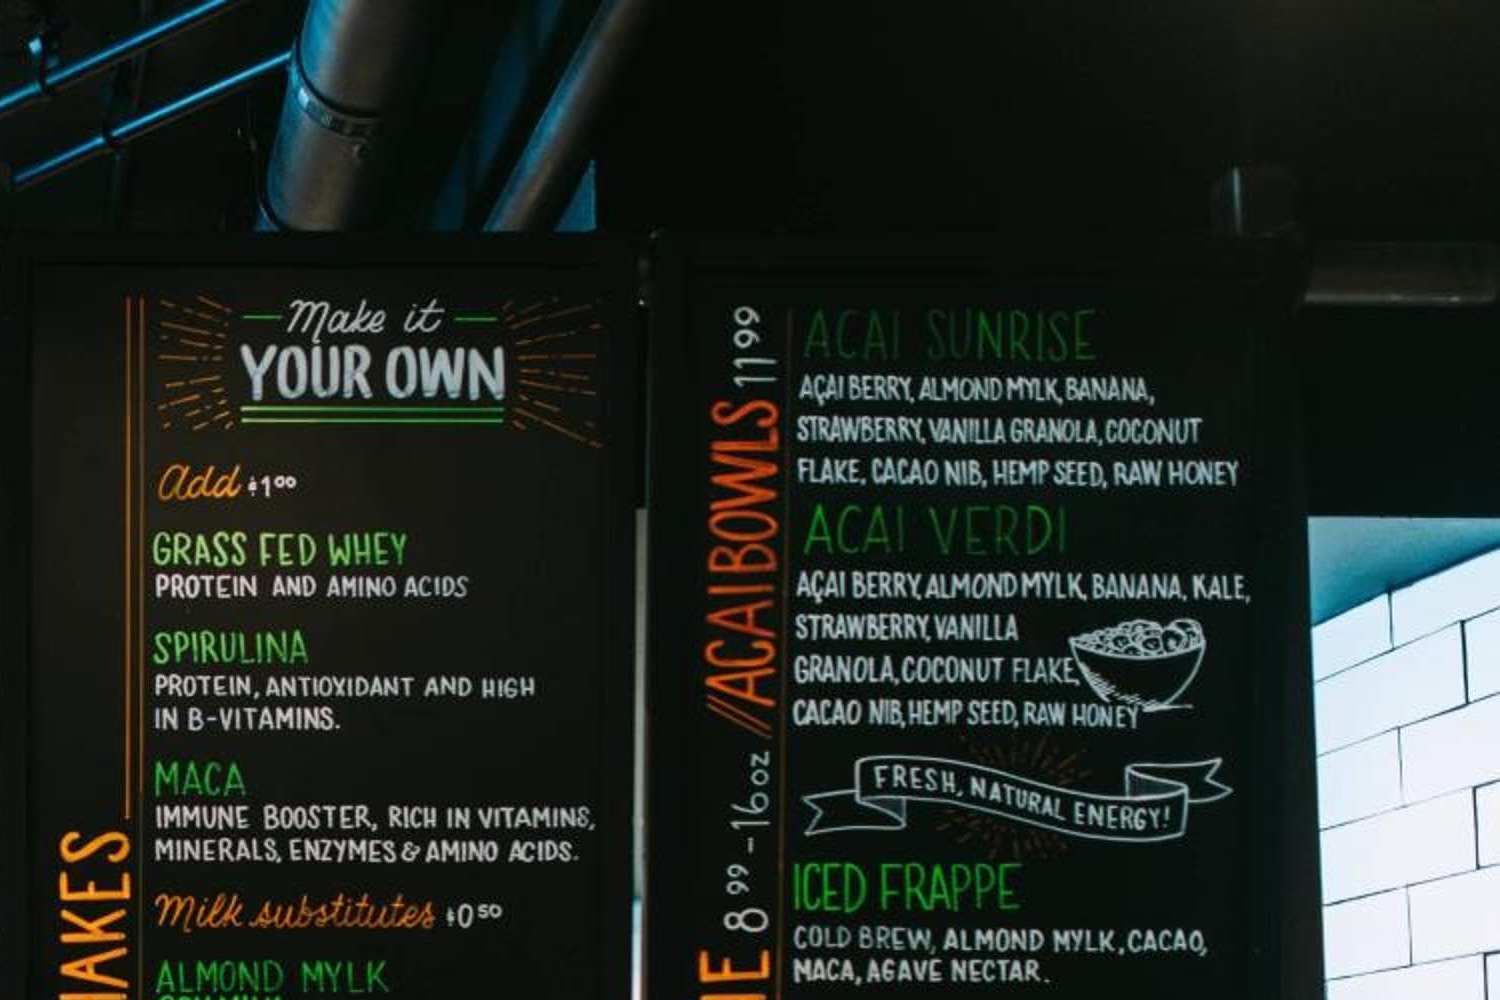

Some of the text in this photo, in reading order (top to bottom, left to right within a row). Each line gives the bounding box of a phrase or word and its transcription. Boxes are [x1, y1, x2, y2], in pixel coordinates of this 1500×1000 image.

[286, 298, 445, 345] Make it
[803, 308, 1096, 363] ACAI SUNRISE
[240, 344, 505, 401] YOUR OWN
[927, 417, 1007, 445] VANILLA
[1105, 417, 1203, 445] COCONUT
[803, 503, 1066, 556] ACAI VERDI
[152, 531, 407, 568] GRASS FED WHEY
[704, 399, 779, 708] ACAI BOWLS
[155, 573, 469, 599] PROTEIN AND AMINO ACIDS
[933, 613, 1019, 642] VANILLA
[153, 629, 309, 665] SPIRULINA
[265, 675, 415, 697] ANTIOXIDANT
[424, 675, 473, 697] AND
[481, 676, 535, 699] HIGH
[154, 705, 341, 732] IN B-VITAMINS.
[154, 760, 246, 797] MACA
[155, 804, 249, 831] IMMUNE
[388, 805, 437, 829] RICH
[446, 807, 471, 830] IN
[968, 776, 1067, 823] NATURAL
[1074, 801, 1170, 831] ENERGY!
[793, 862, 1022, 914] ICED FRAPPE
[154, 893, 243, 933] Milk
[248, 893, 436, 929] substitutes
[155, 959, 389, 994] ALMOND MYLK
[866, 958, 943, 983] AGAVE
